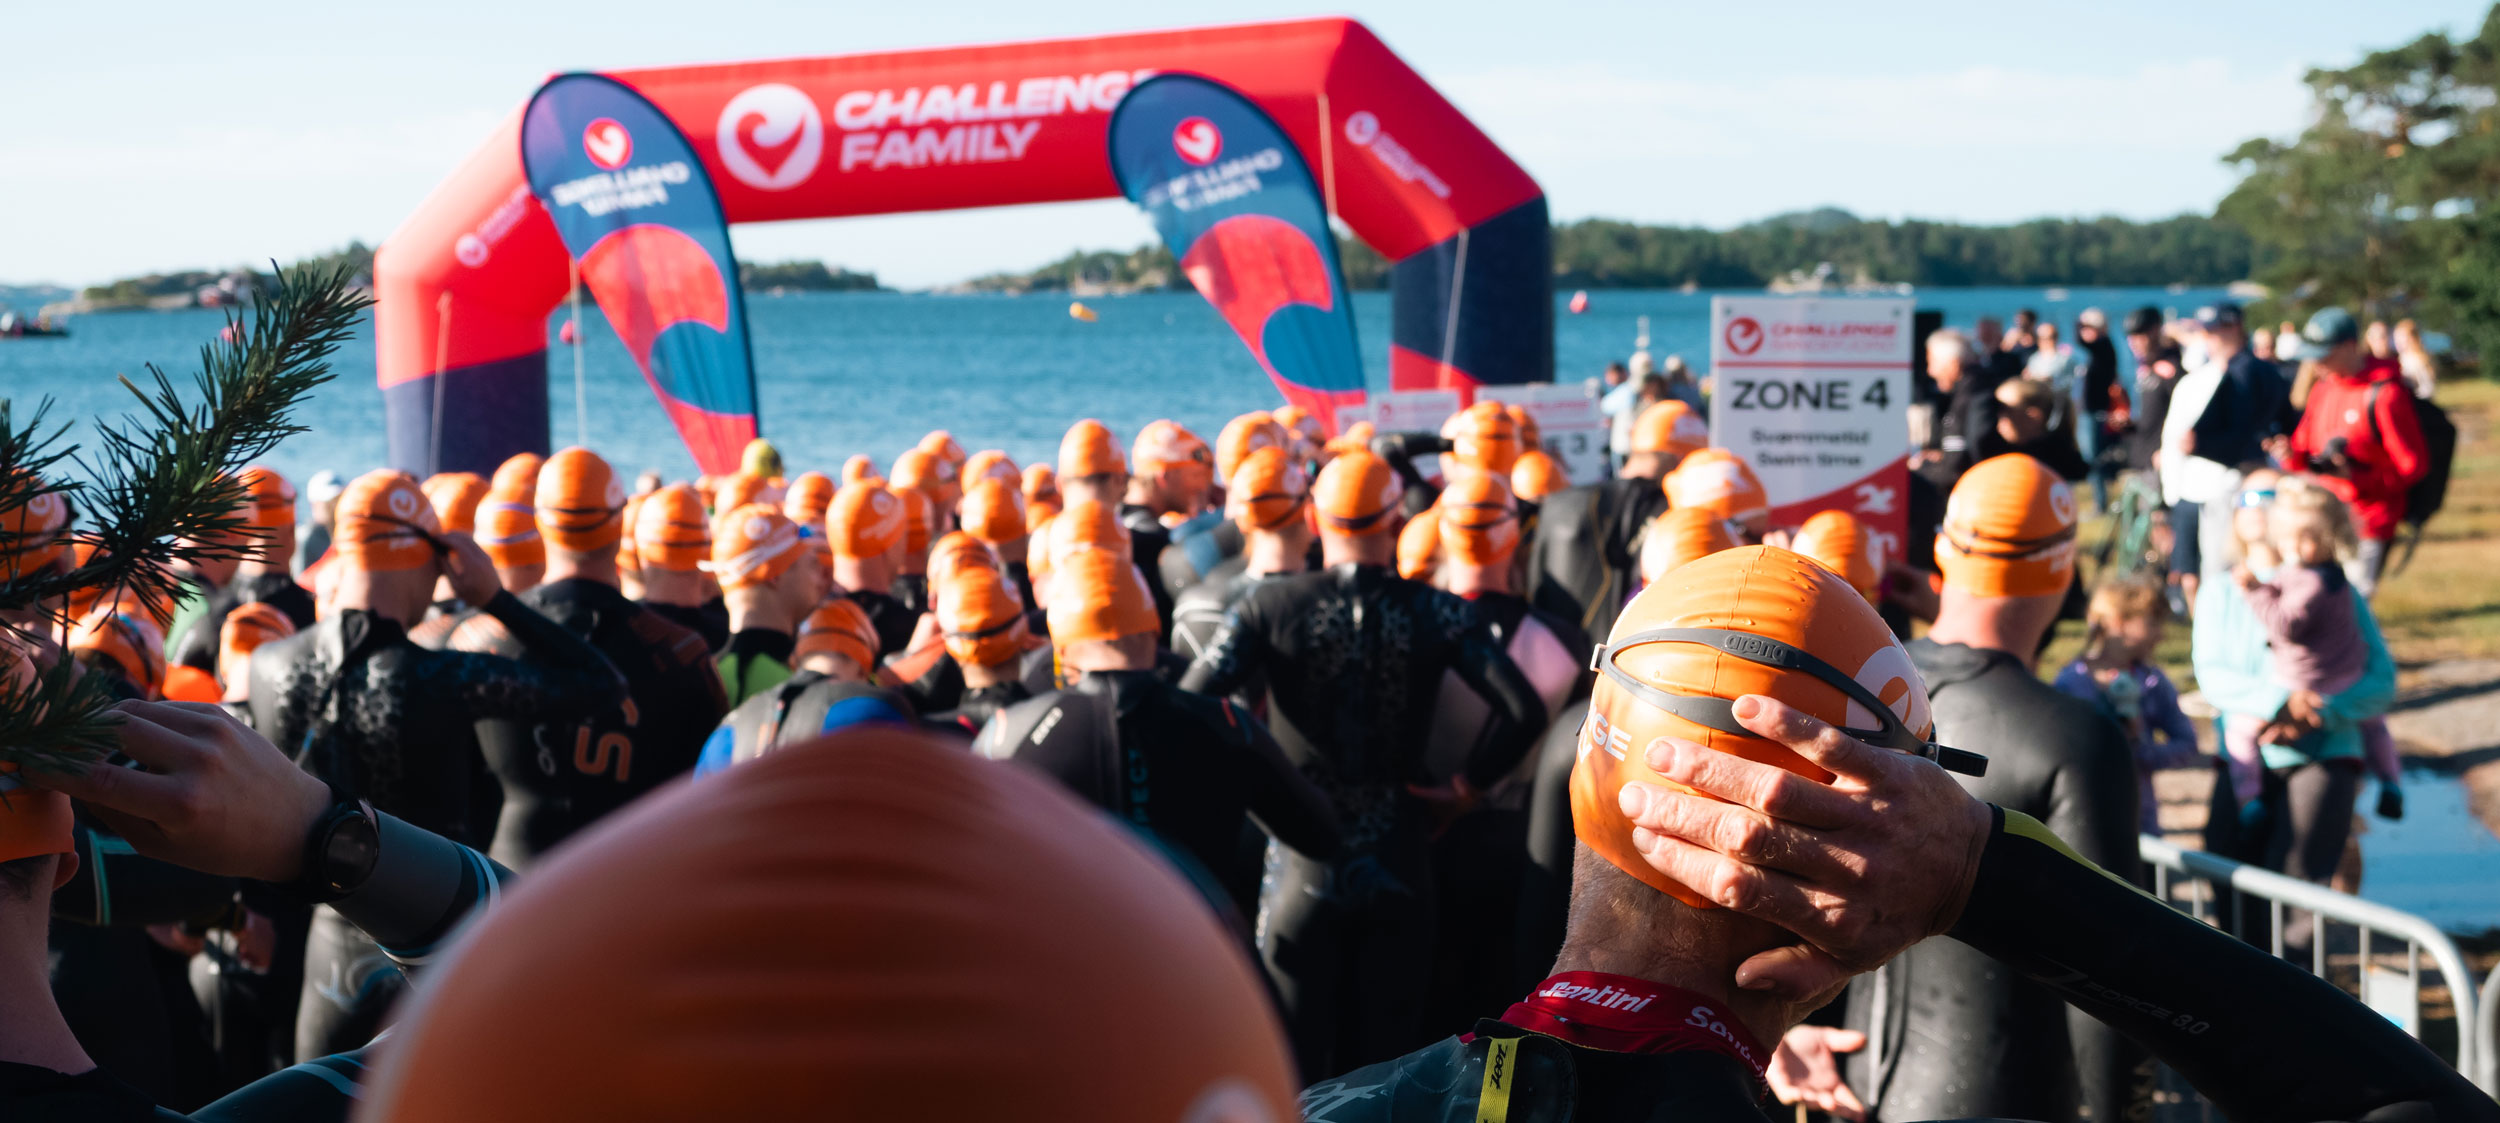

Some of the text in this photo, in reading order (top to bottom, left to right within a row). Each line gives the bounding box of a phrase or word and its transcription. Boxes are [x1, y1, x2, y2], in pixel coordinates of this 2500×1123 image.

[838, 120, 1041, 172] FAMILY
[1731, 377, 1891, 411] ZONE 4
[1758, 453, 1863, 467] Swim time
[1725, 634, 1786, 662] arena
[1539, 981, 1657, 1012] Santini
